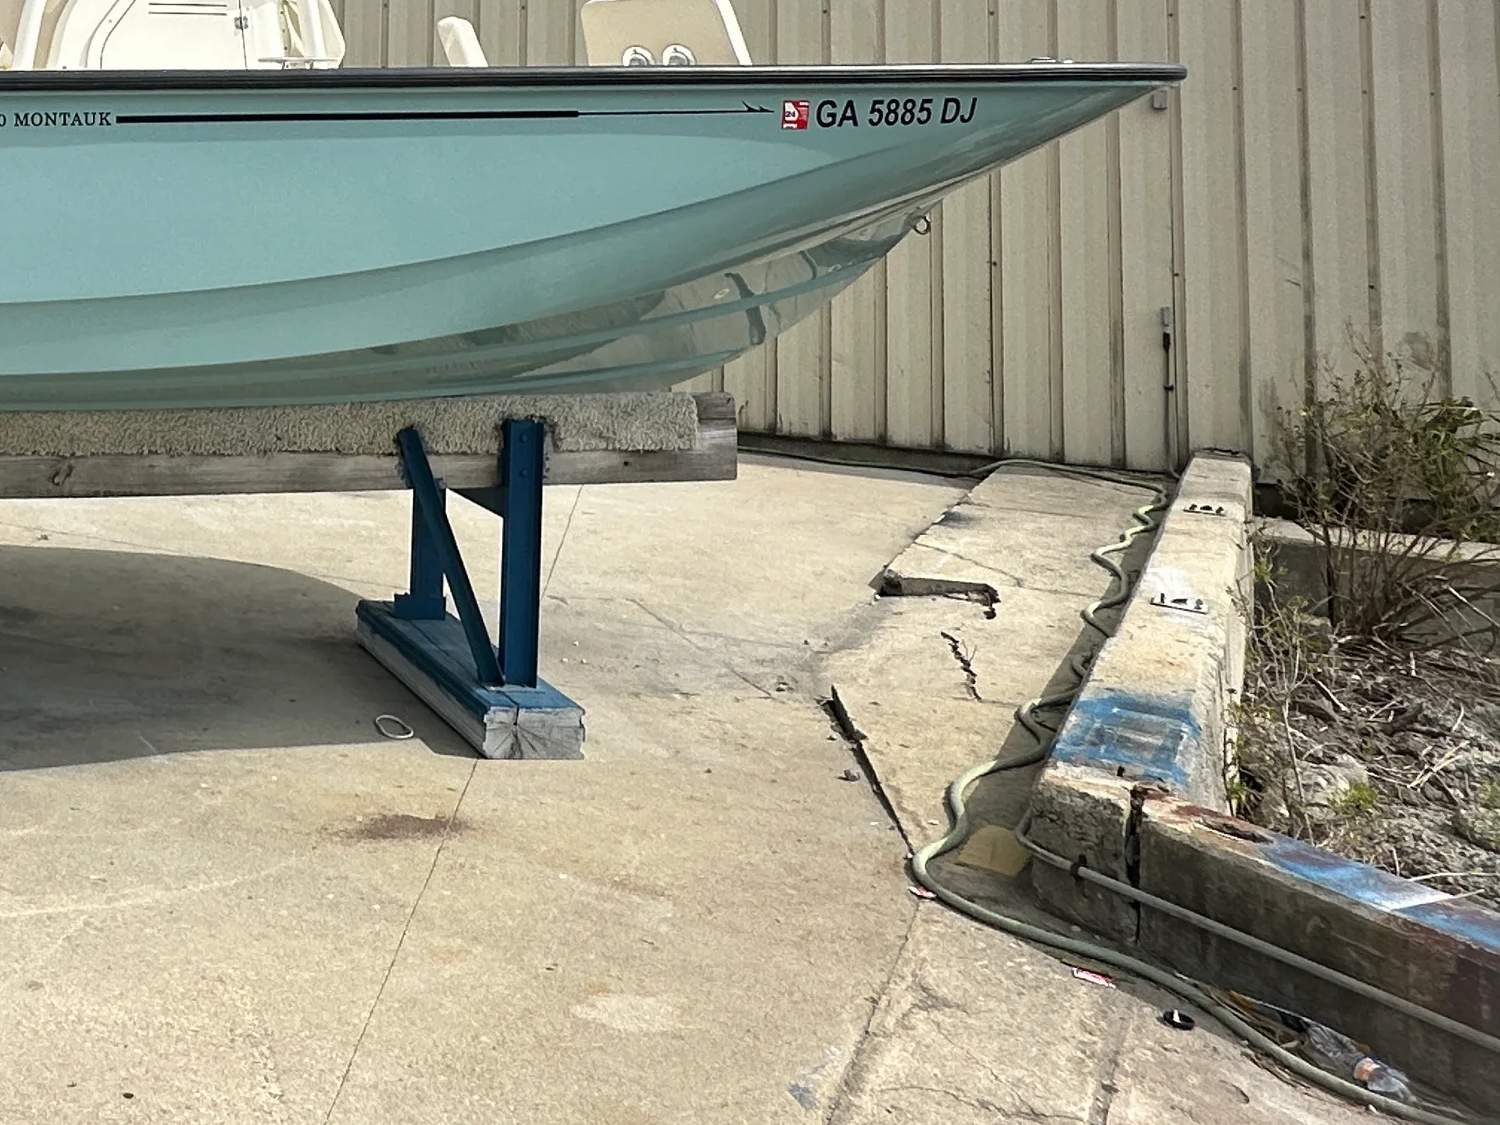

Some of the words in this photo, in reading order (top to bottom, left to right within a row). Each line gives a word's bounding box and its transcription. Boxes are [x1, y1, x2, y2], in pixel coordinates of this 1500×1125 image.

[14, 112, 112, 127] MONTAUK
[816, 99, 859, 128] GA
[868, 98, 933, 127] 5885
[940, 97, 978, 124] DJ
